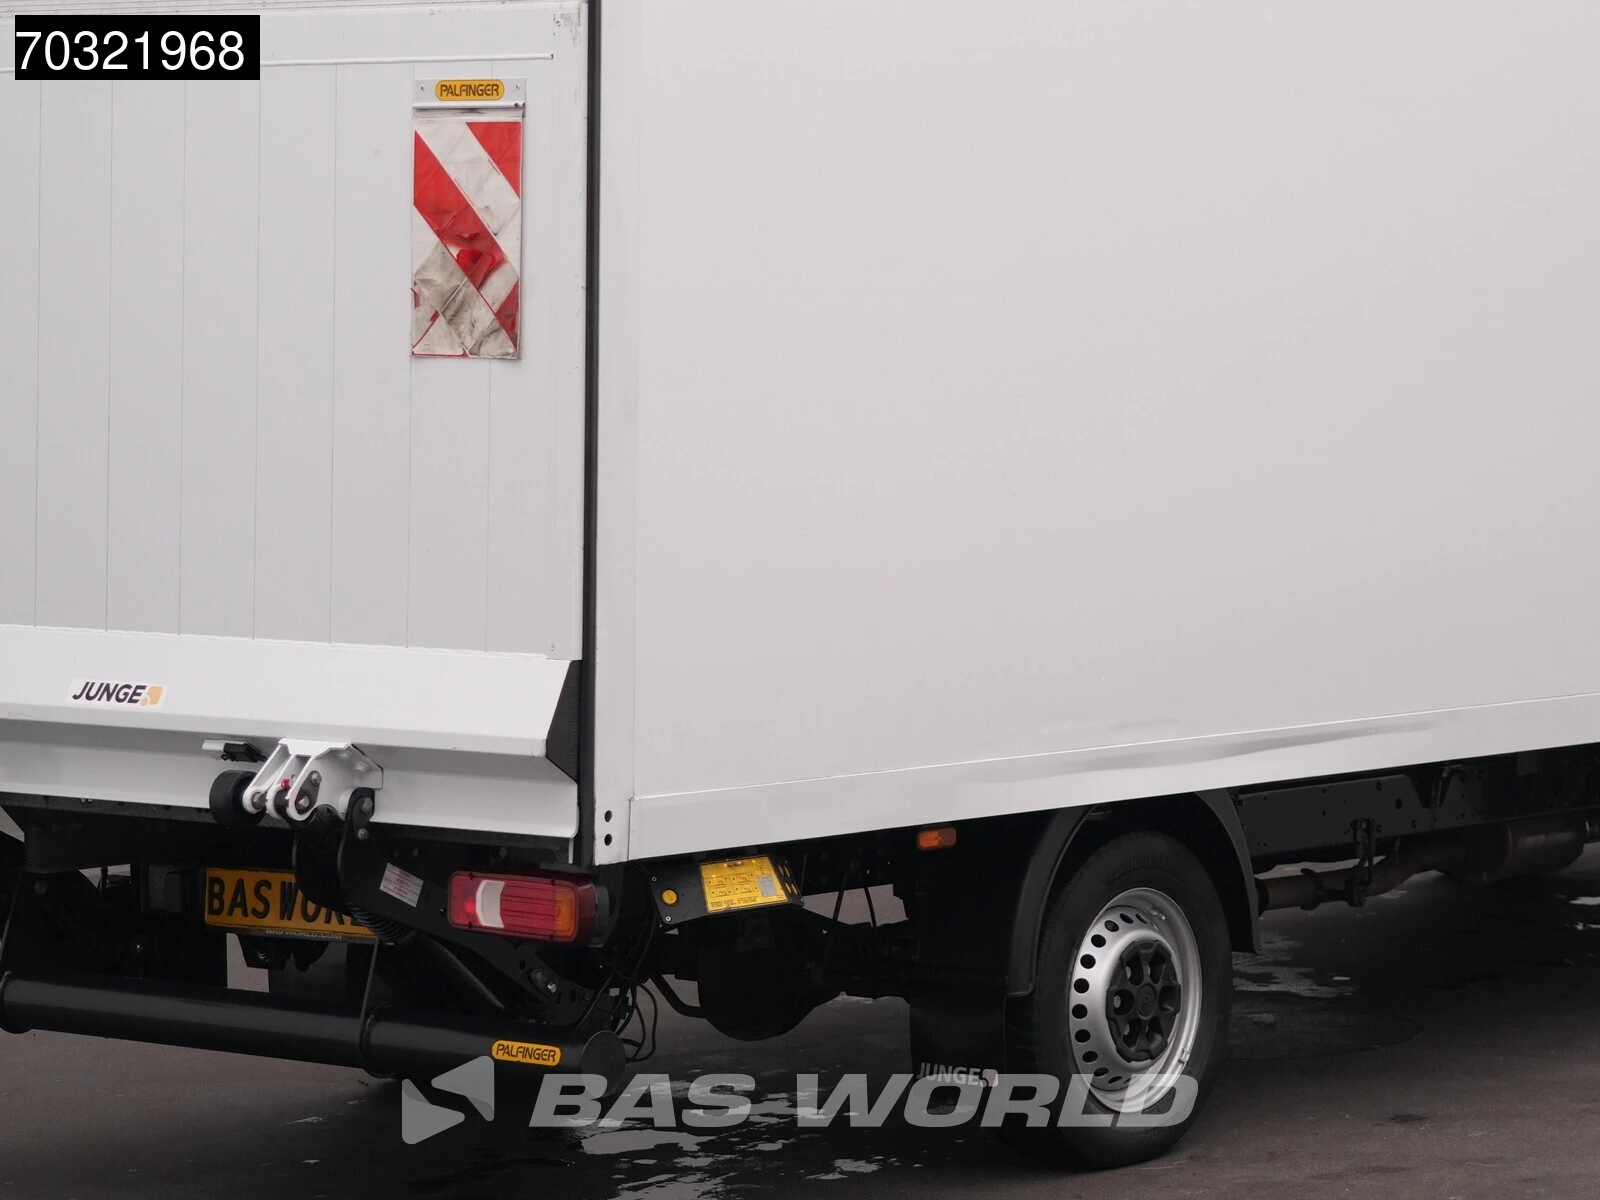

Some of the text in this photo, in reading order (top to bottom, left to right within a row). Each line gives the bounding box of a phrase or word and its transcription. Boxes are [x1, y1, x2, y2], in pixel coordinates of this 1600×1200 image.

[440, 84, 500, 96] PALFINGER
[72, 681, 147, 703] JUNGE
[207, 876, 273, 920] BAS
[496, 1043, 557, 1062] PALFINGER
[916, 1062, 981, 1086] JUNGE
